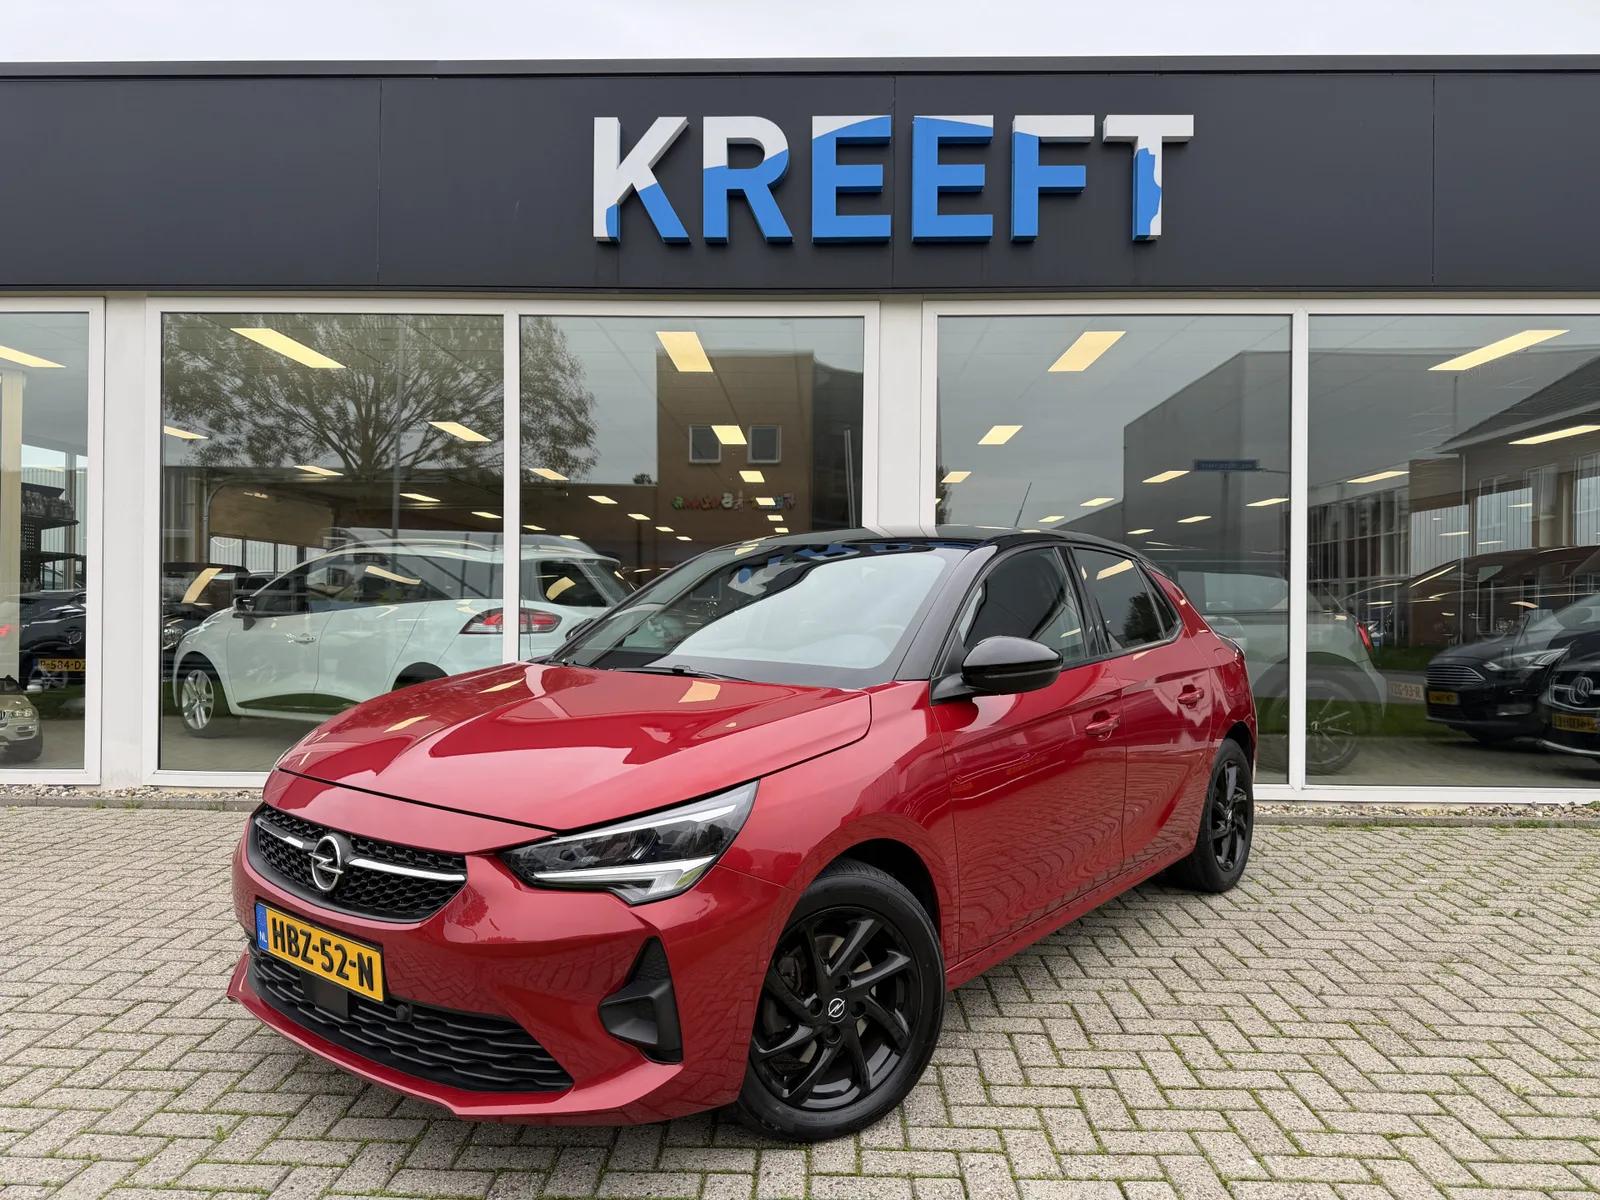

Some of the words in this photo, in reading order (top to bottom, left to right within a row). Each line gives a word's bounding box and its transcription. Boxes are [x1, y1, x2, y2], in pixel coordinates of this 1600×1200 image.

[593, 114, 1194, 243] KREEFT
[259, 931, 268, 943] NL
[271, 917, 374, 992] HBZ-52-N
